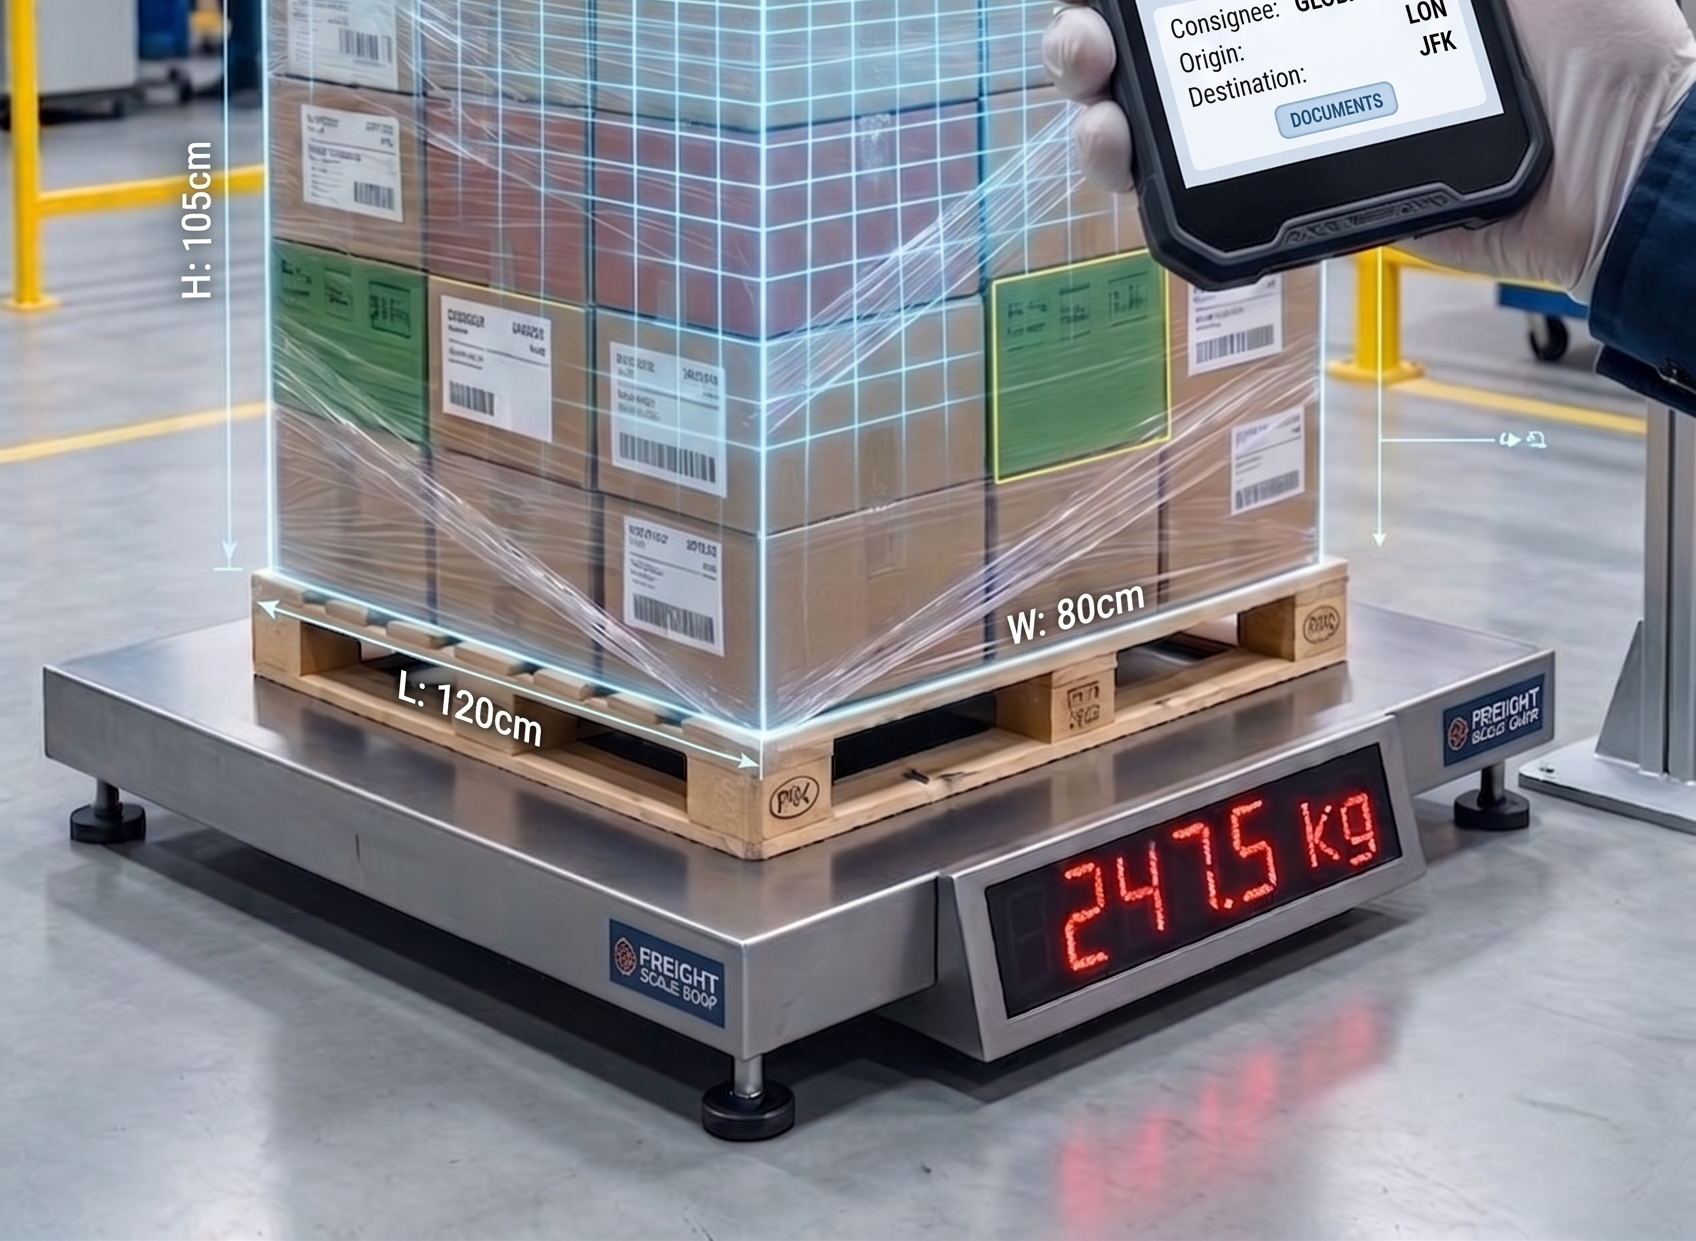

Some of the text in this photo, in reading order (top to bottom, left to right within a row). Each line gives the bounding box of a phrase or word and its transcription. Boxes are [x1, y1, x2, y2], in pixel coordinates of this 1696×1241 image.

[1170, 0, 1281, 40] Consignee:
[1179, 42, 1245, 75] Origin:
[1188, 29, 1458, 108] Destination: JFK
[1289, 92, 1385, 129] DOCUMENTS
[1064, 791, 1378, 972] 247.5 kg
[639, 945, 720, 995] FREIGHT
